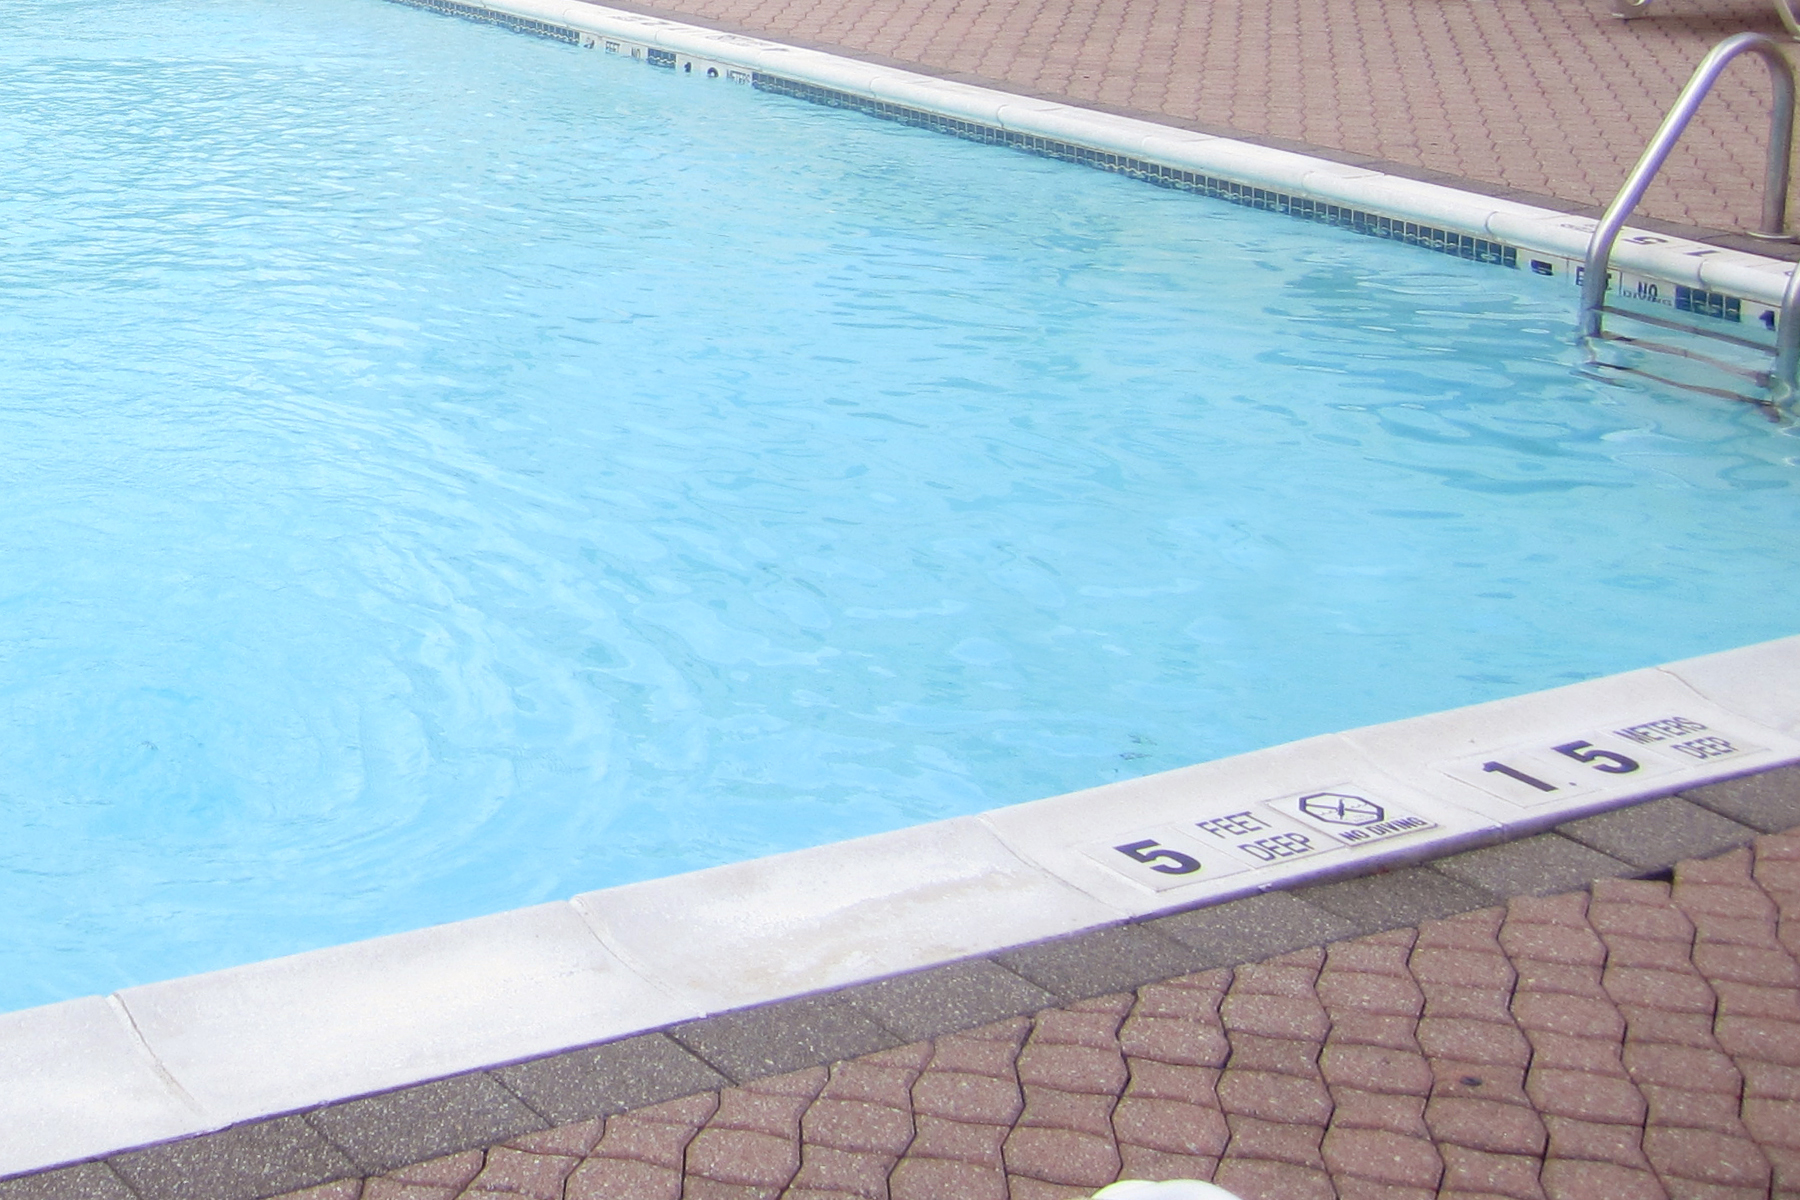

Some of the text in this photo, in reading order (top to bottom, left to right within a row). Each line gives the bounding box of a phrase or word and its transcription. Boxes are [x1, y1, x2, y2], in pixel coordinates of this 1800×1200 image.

[1613, 716, 1708, 744] METERS
[1670, 736, 1739, 760] DEEP
[1113, 810, 1273, 875] 5 FEET
[1338, 816, 1429, 842] NO DIVING
[1237, 832, 1315, 861] DEEP
